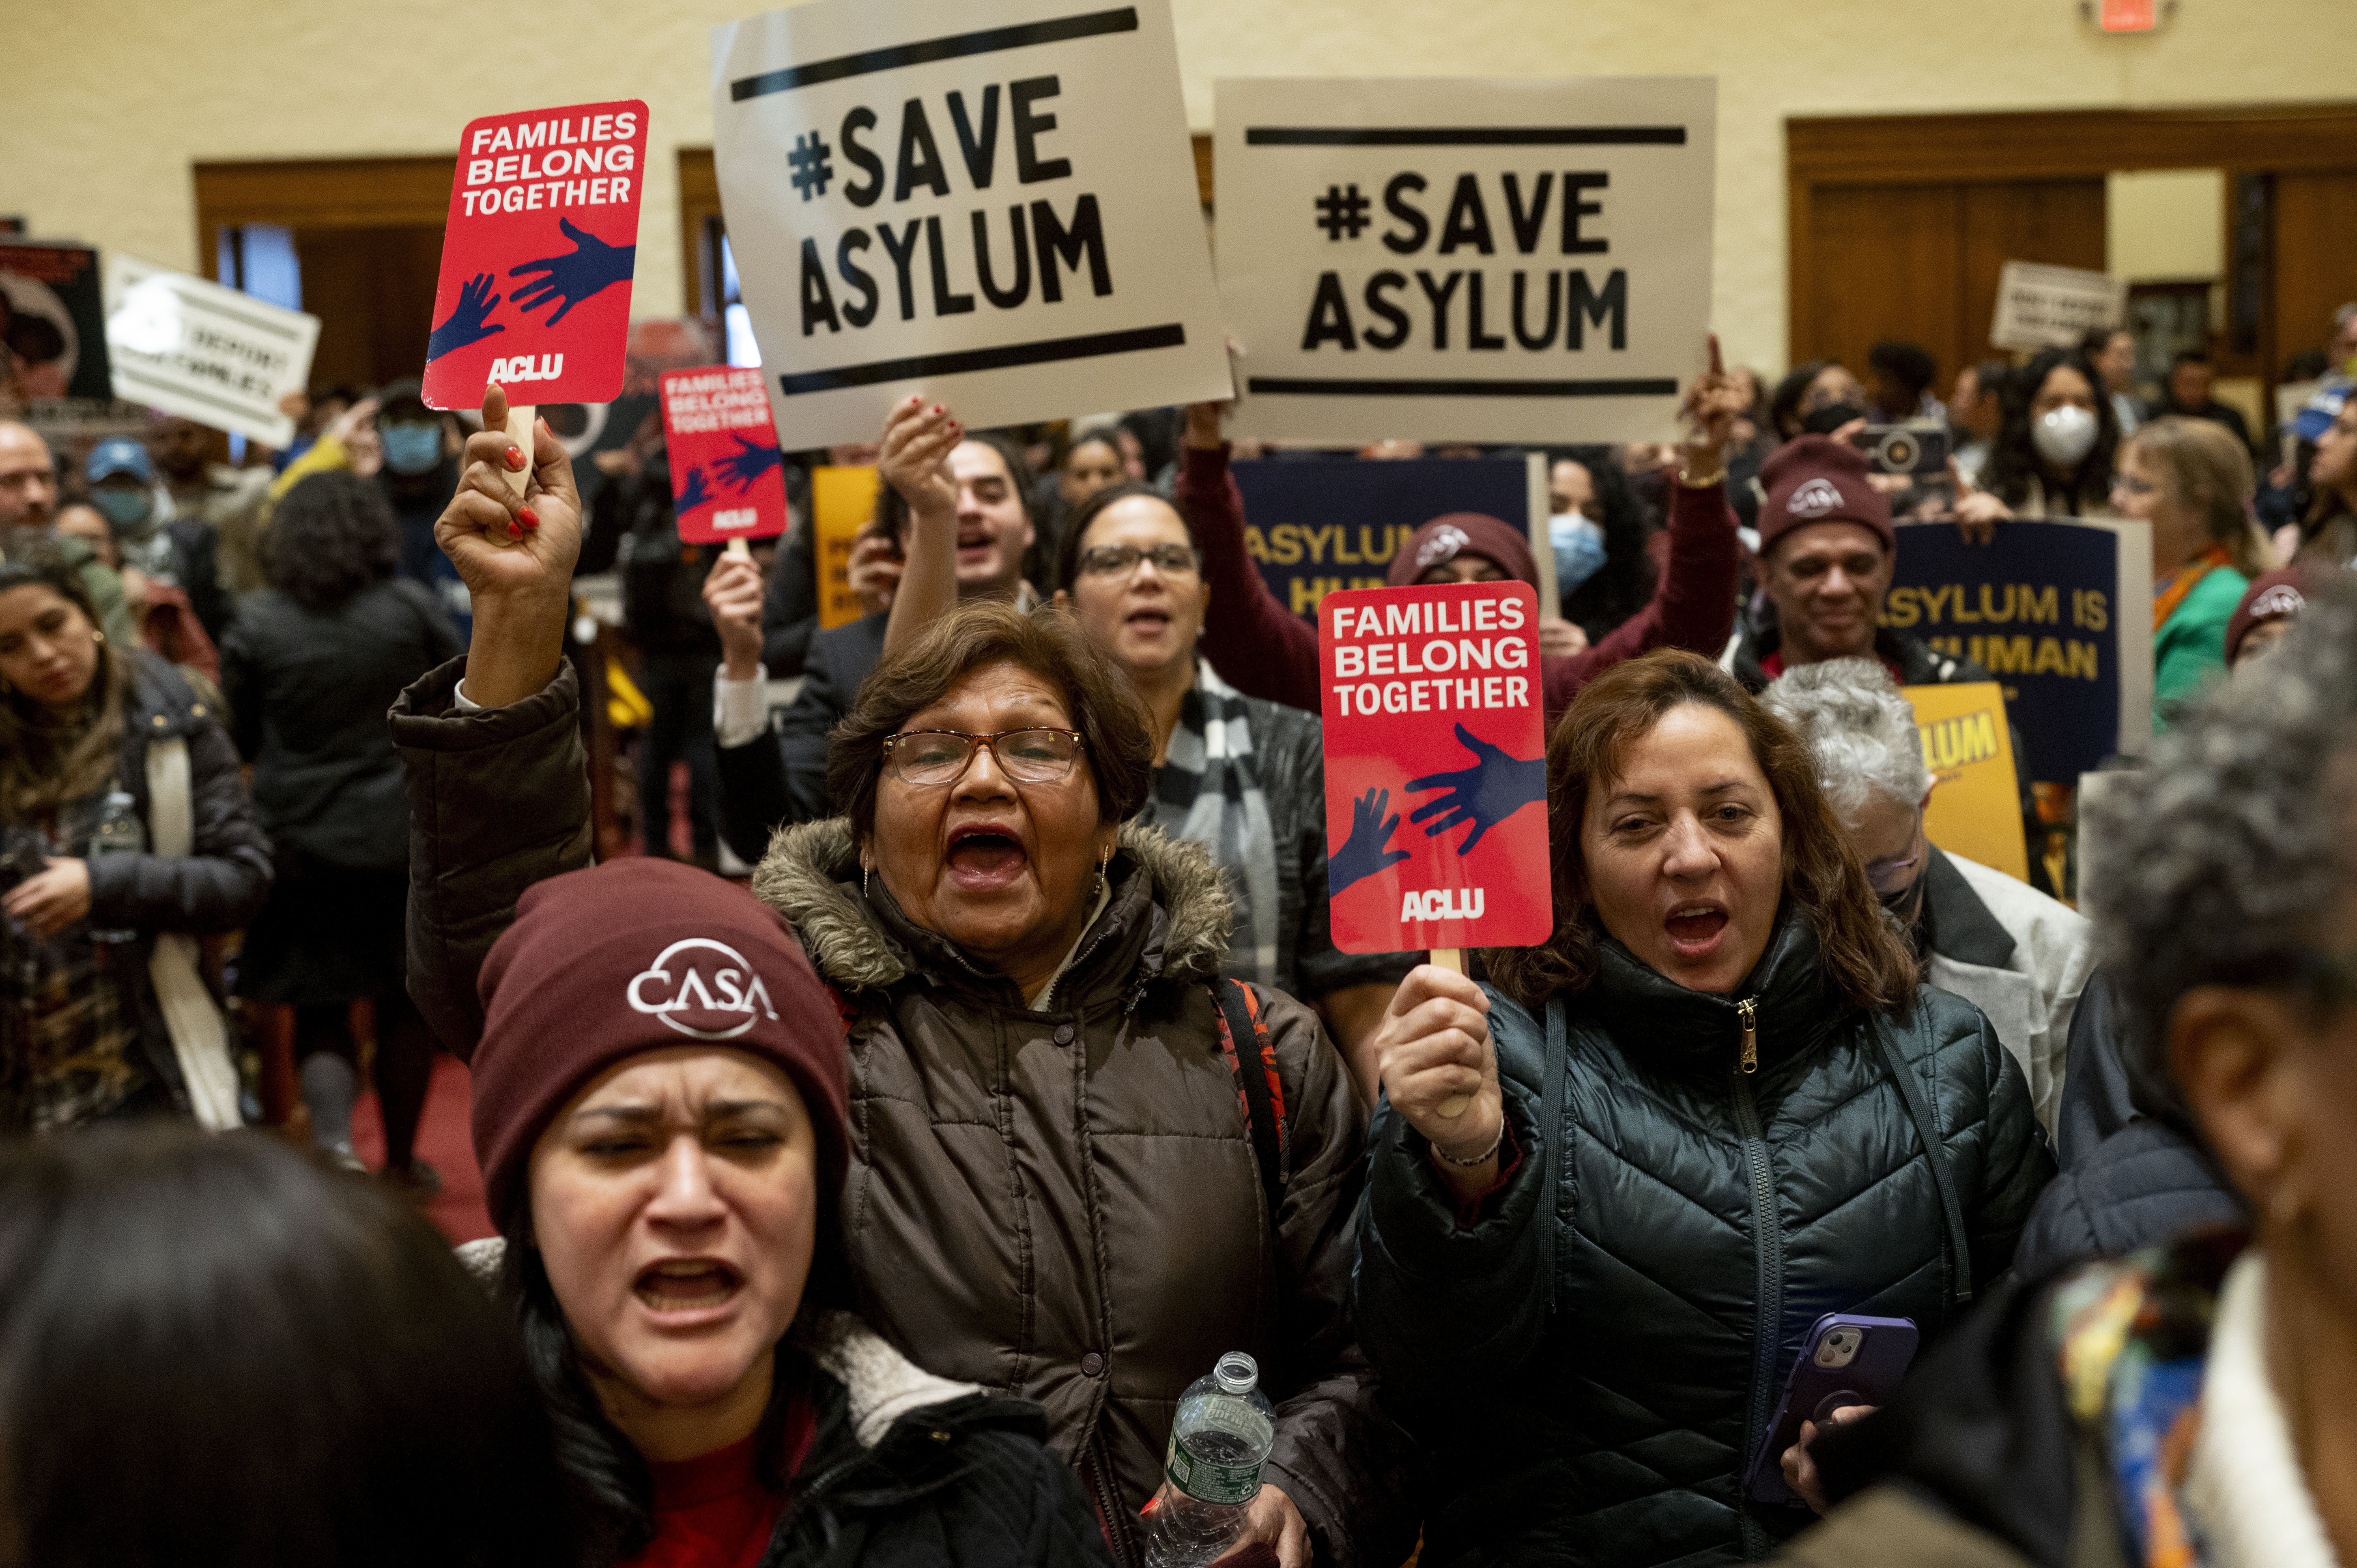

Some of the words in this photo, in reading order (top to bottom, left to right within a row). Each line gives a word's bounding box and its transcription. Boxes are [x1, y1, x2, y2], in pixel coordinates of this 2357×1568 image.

[471, 112, 637, 155] FAMILIES
[787, 74, 1073, 207] #SAVE
[467, 144, 635, 186] BELONG
[462, 177, 631, 217] TOGETHER
[1315, 171, 1609, 255] #SAVE
[800, 193, 1113, 337] ASYLUM
[1301, 268, 1627, 351] ASYLUM
[487, 353, 563, 384] ACLU
[1245, 523, 1412, 565] ASYLU
[1333, 597, 1525, 639] FAMILIES
[1877, 583, 2060, 627] SYLUM
[2071, 588, 2109, 632] IS
[1335, 636, 1528, 678] BELONG
[1333, 676, 1529, 716] TOGETHER
[1401, 888, 1484, 922] ACLU
[627, 967, 780, 1021] CASA
